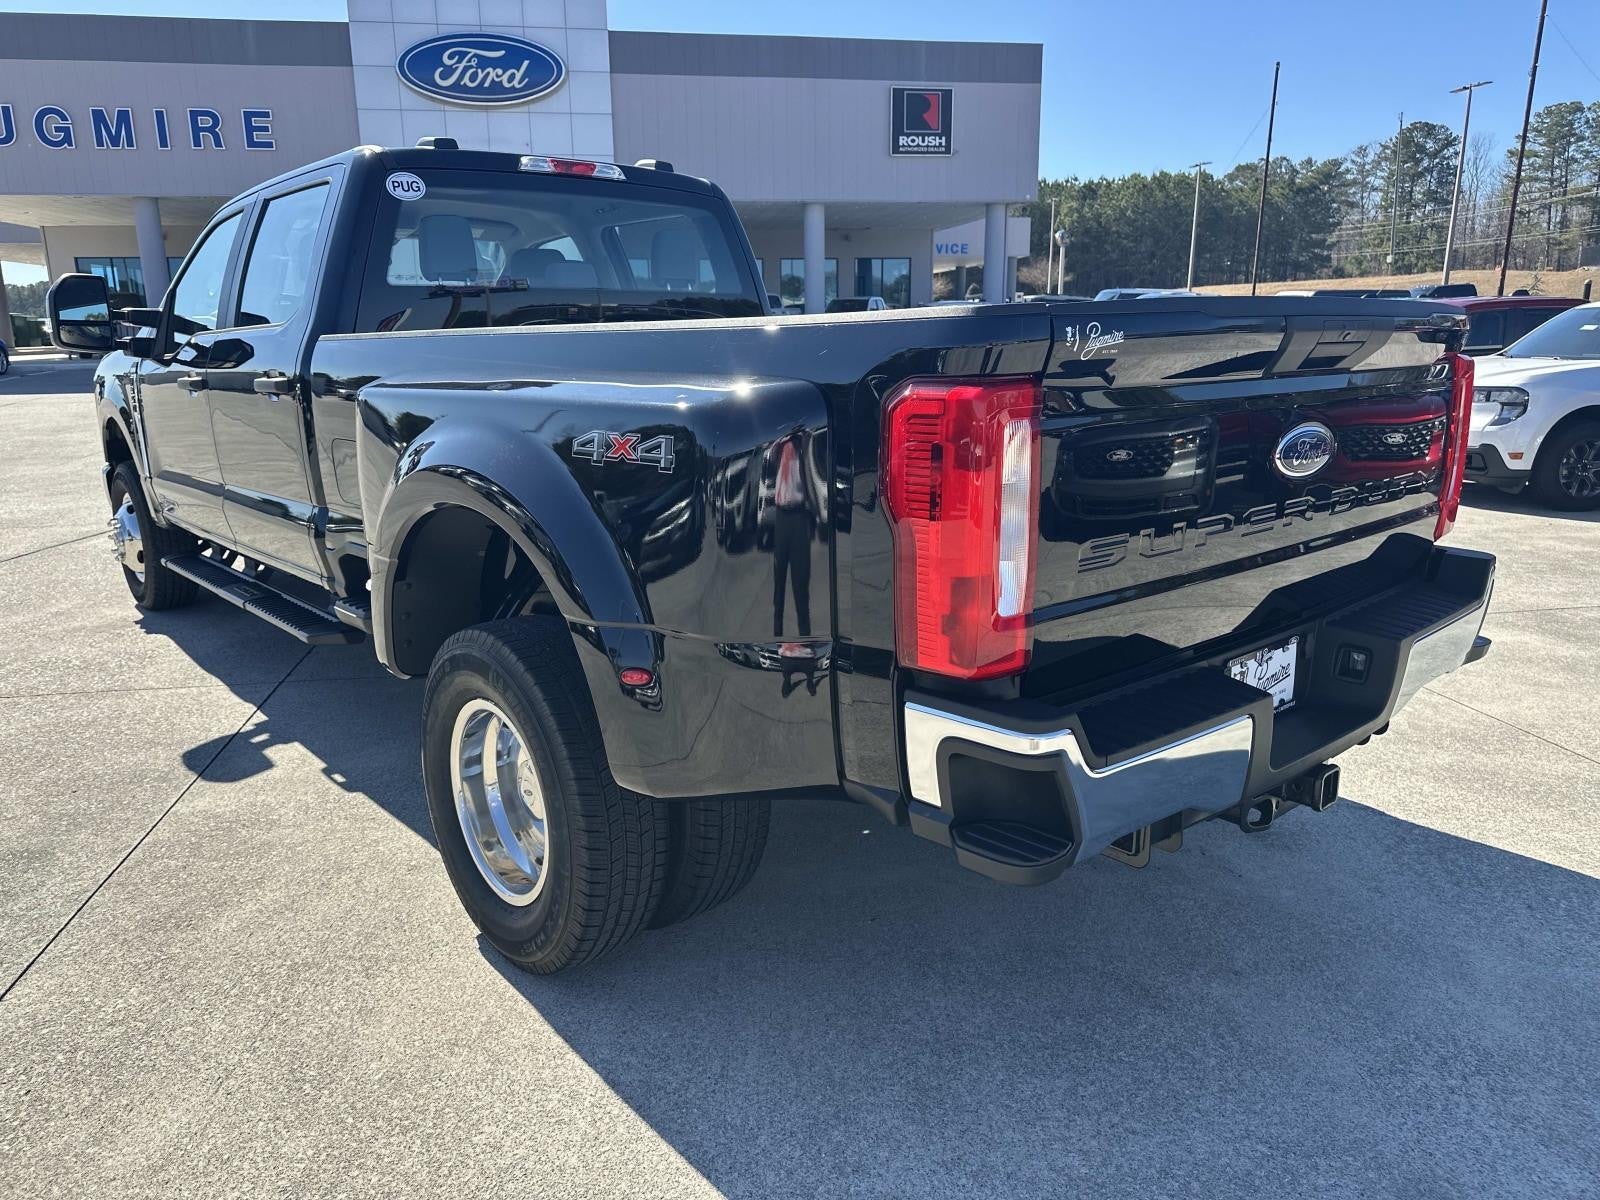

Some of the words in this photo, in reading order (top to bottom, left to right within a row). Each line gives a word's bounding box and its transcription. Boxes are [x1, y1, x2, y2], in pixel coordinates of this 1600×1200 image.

[434, 47, 530, 88] Ford
[899, 135, 946, 146] ROUSH
[391, 180, 421, 192] PUG
[935, 243, 969, 255] VICE
[1081, 321, 1125, 360] Pugmire
[1077, 494, 1318, 574] SUPER
[1328, 467, 1438, 516] DUTY
